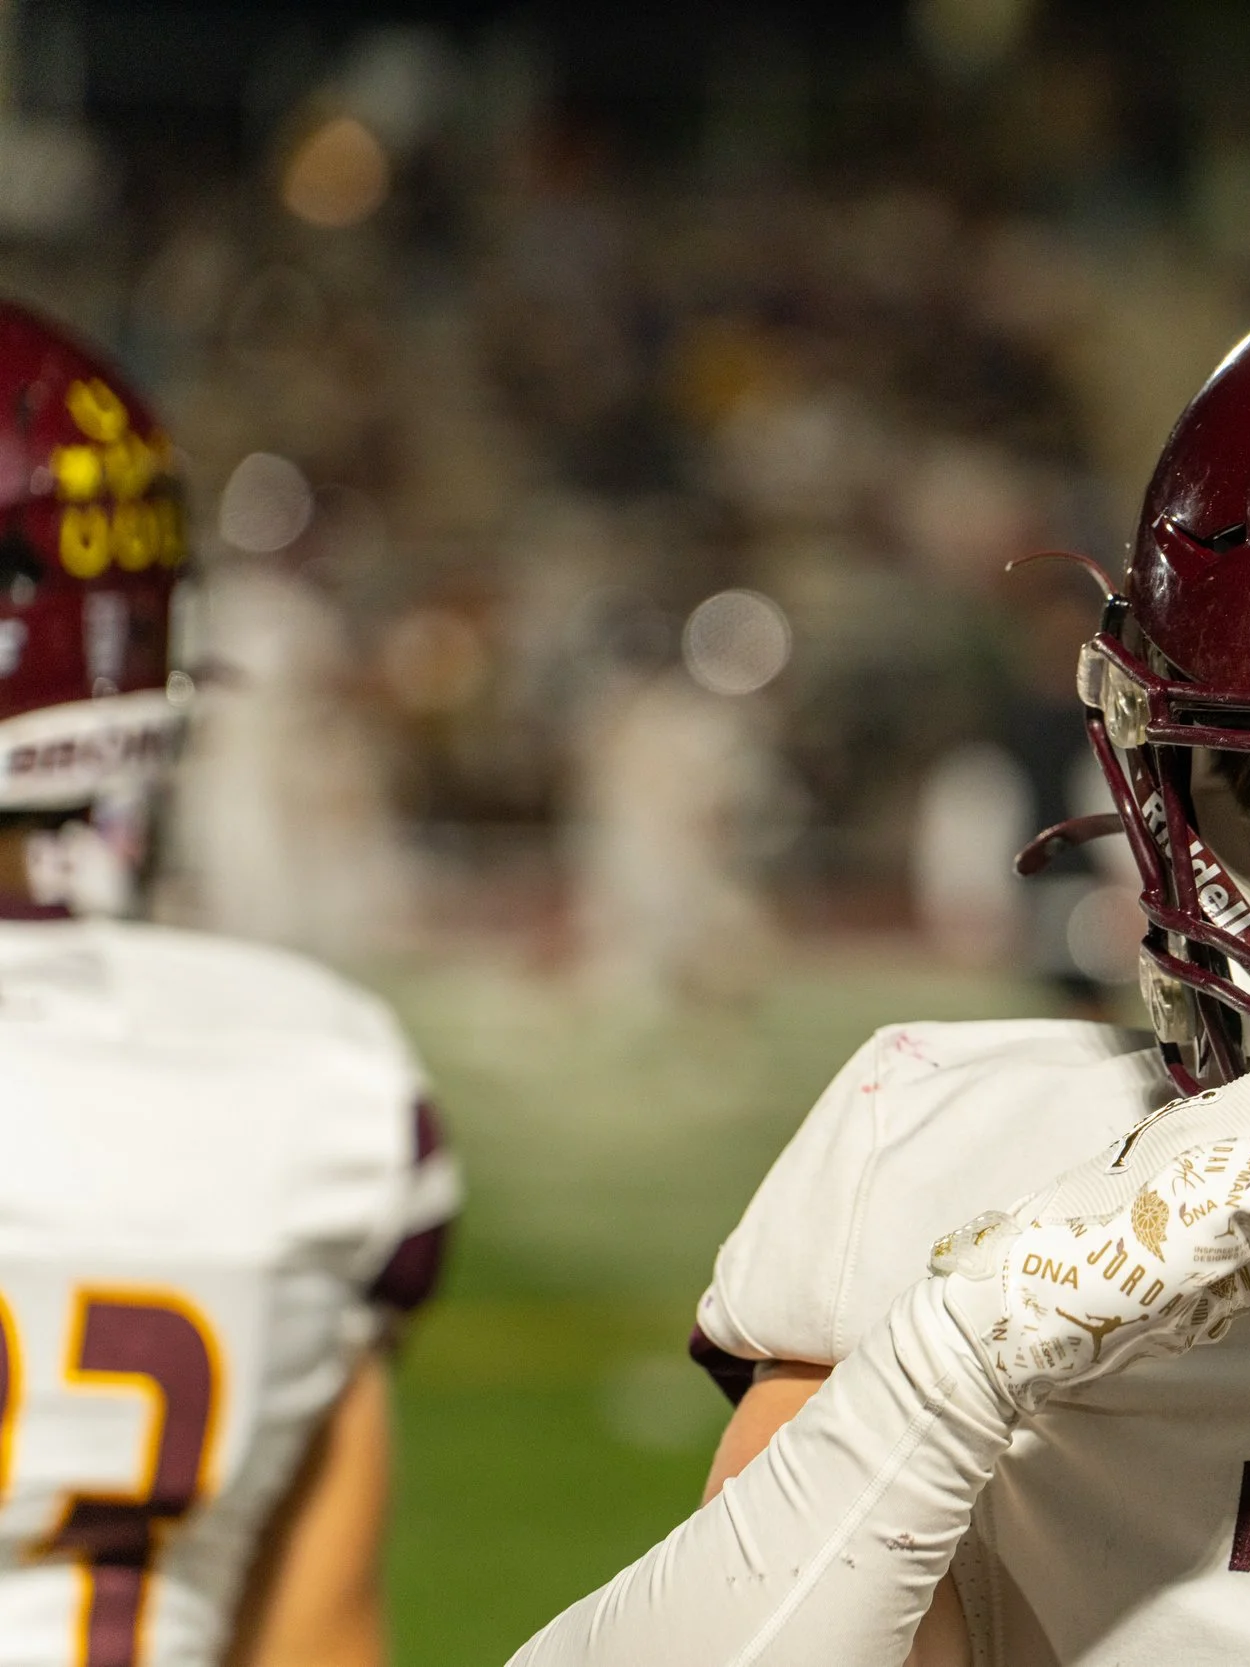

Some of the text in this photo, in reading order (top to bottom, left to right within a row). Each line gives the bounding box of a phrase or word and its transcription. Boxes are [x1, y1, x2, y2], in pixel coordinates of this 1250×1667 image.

[1183, 1200, 1217, 1228] DNA
[1022, 1253, 1079, 1290] DNA
[1087, 1240, 1185, 1317] JORDA
